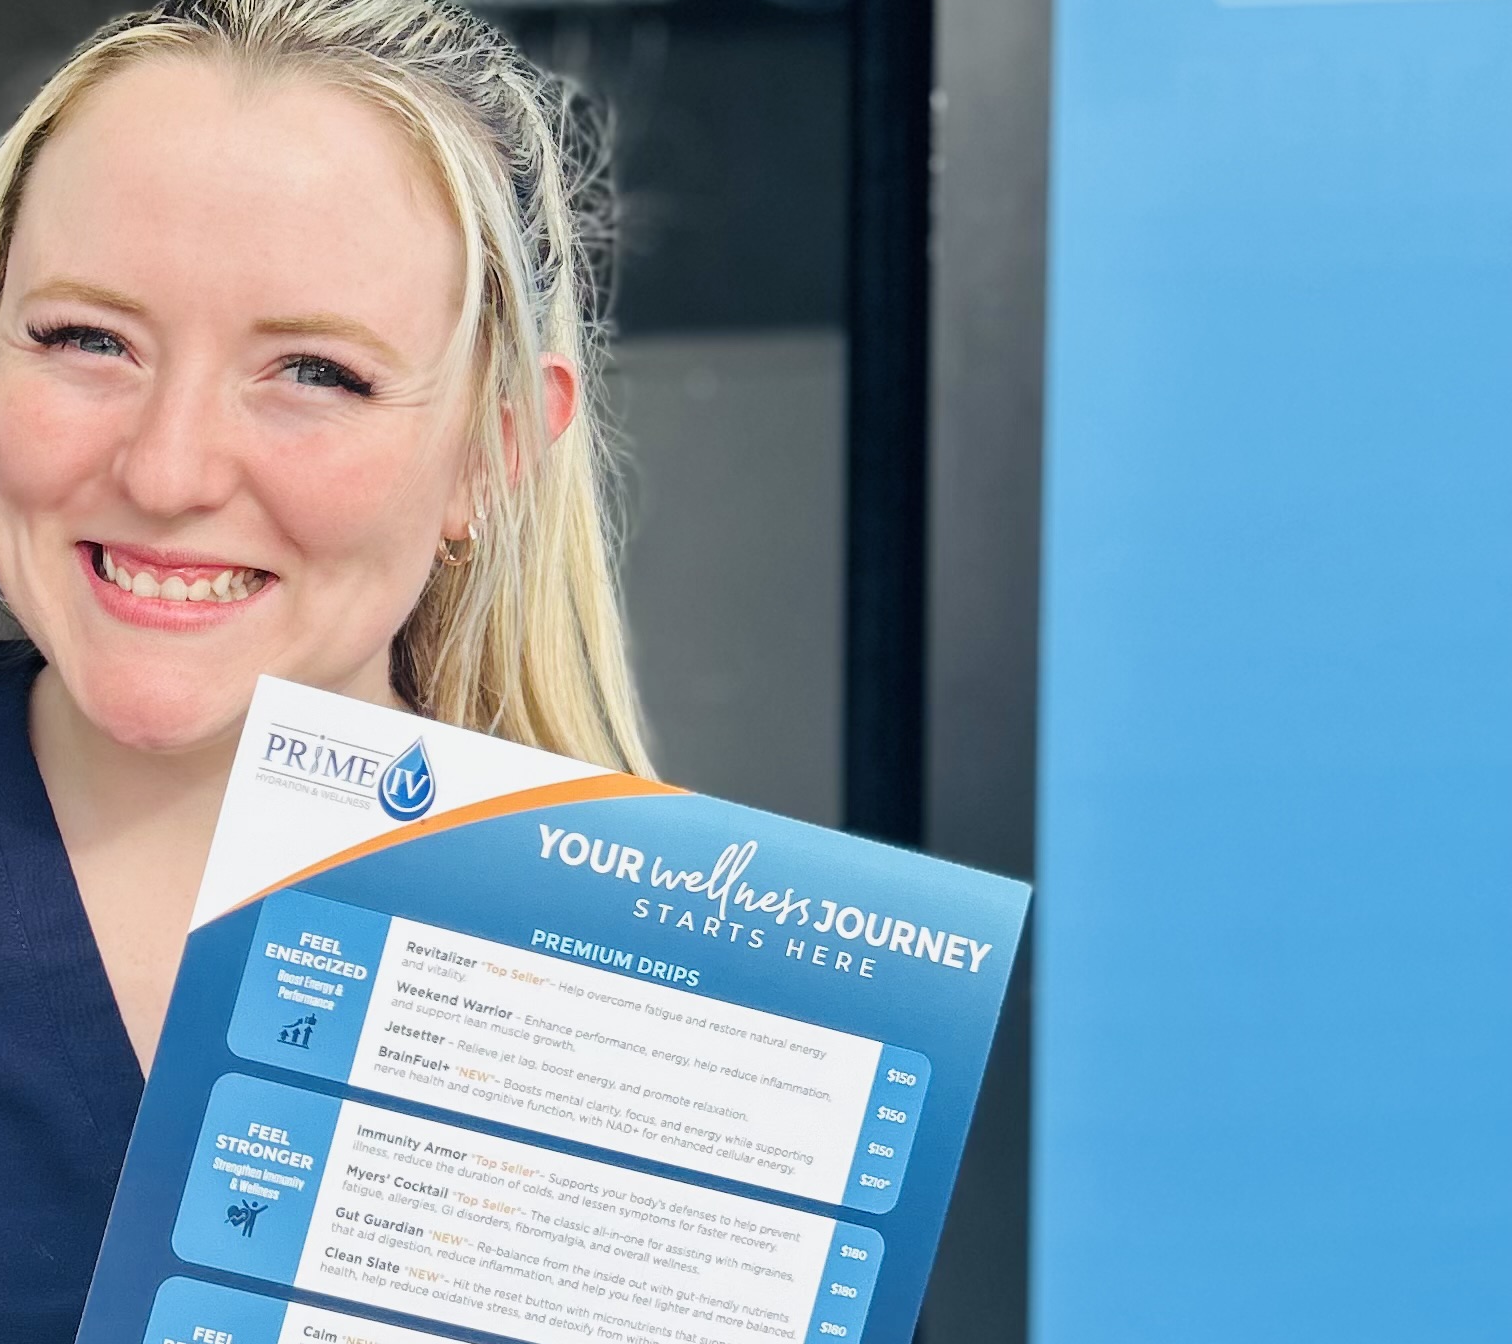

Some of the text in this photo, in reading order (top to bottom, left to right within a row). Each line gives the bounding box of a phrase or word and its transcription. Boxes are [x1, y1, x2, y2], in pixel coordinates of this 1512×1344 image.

[262, 732, 429, 803] PRIME IV
[538, 823, 992, 973] YOUR wellness JOURNEY
[298, 931, 342, 956] FEEL
[404, 939, 478, 969] Revitalizer
[632, 897, 876, 978] STARTS HERE
[264, 942, 368, 980] ENERGIZED
[530, 928, 700, 987] PREMIUM DRIPS
[395, 979, 514, 1020] Weekend Warrior
[376, 1044, 451, 1072] BrainFuel+
[383, 1019, 748, 1122] Jetsetter Relieve jet lag, boost energy, and promote relaxation.
[886, 1067, 916, 1086] $150
[876, 1105, 907, 1123] $150
[215, 1133, 314, 1170] STRONGER
[247, 1122, 290, 1146] FEEL
[355, 1123, 468, 1162] Immunity Armor
[867, 1141, 894, 1158] $150
[345, 1163, 449, 1199] Myers' Cocktail
[334, 1205, 424, 1238] Gut Guardian
[323, 1245, 400, 1274] Clean Slate
[330, 1221, 796, 1340] that aid digestion, reduce inflammation, and help you feel lighter and more balanced.
[302, 1324, 338, 1344] Calm
